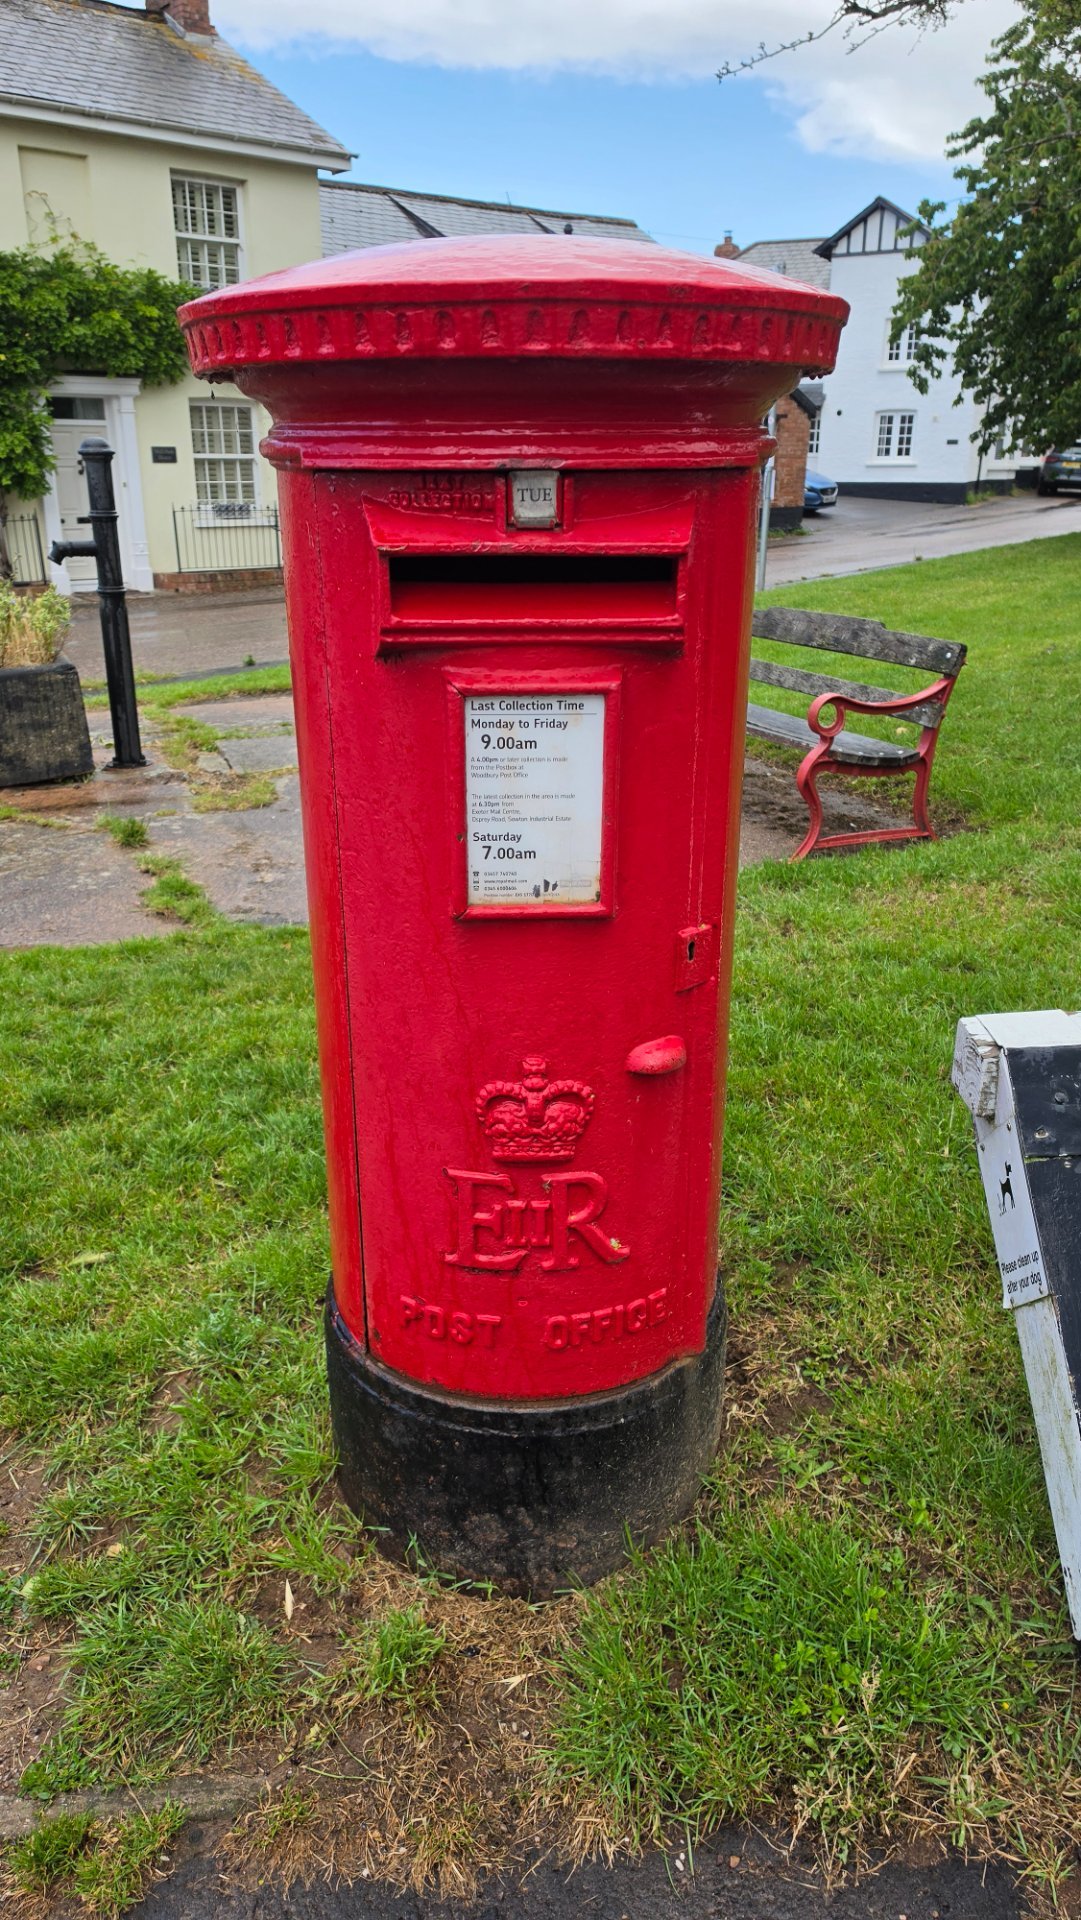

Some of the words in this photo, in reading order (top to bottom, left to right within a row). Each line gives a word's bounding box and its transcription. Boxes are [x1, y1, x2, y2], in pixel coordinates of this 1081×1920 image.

[388, 490, 495, 507] COLLECTION
[517, 488, 552, 502] TUE
[471, 700, 495, 711] Last
[498, 700, 553, 711] Collection
[556, 700, 585, 711] Time
[471, 718, 515, 731] Monday
[518, 719, 530, 729] to
[534, 718, 568, 730] Friday
[481, 734, 537, 750] 9.00am
[476, 756, 499, 764] 4.00pm
[472, 832, 522, 844] Saturday
[481, 845, 537, 860] 7.00am
[1001, 1260, 1018, 1276] Please
[1017, 1254, 1032, 1268] clean
[1031, 1250, 1040, 1264] up
[1007, 1280, 1018, 1294] after
[1019, 1276, 1030, 1293] your
[1030, 1271, 1042, 1286] dog
[400, 1294, 501, 1345] POST
[547, 1287, 667, 1350] OFFICE
